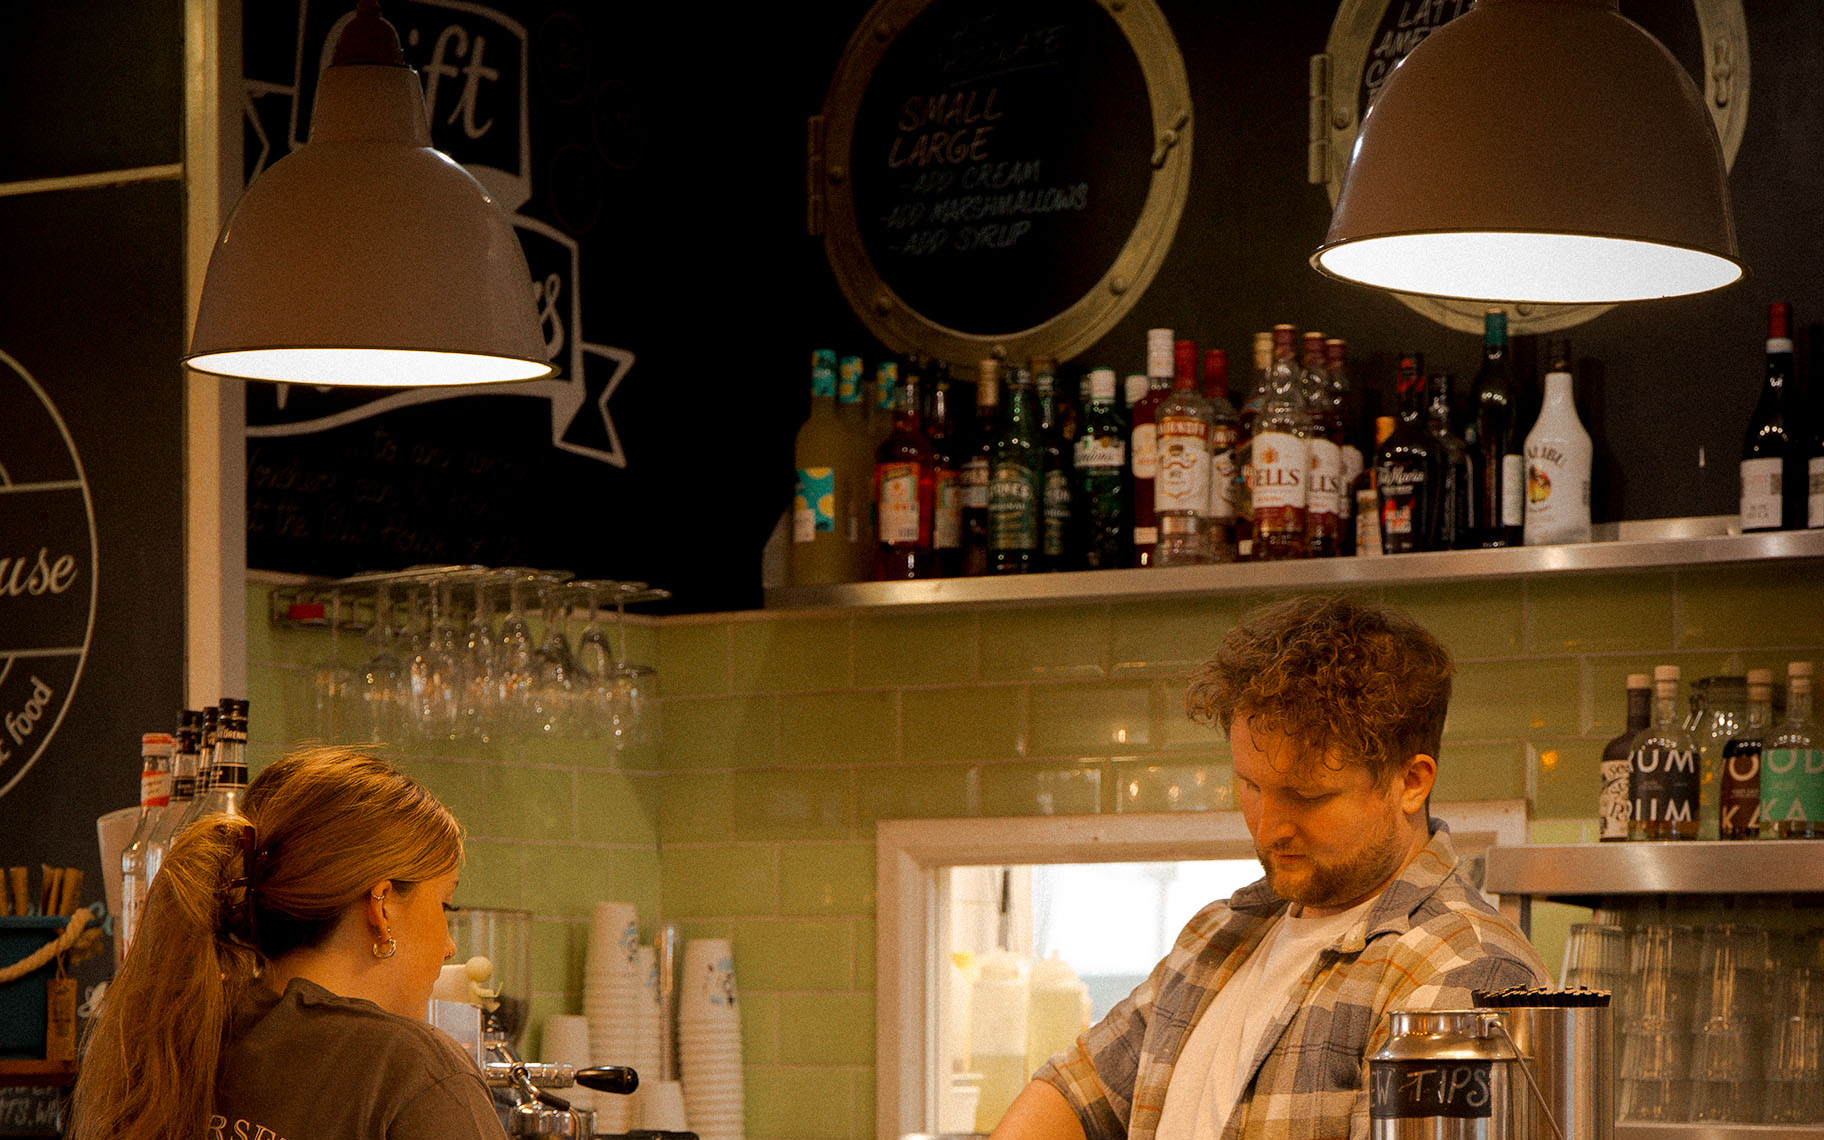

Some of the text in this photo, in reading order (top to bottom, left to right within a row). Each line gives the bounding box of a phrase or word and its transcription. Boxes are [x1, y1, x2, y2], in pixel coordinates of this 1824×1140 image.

[898, 87, 1004, 132] SMALL
[887, 126, 996, 168] LARGE
[961, 159, 1042, 189] CREAM
[929, 183, 1089, 224] MARSHMALLOWS
[953, 220, 1033, 252] SYRUP
[1254, 468, 1301, 487] ELLS
[0, 547, 79, 597] use
[5, 675, 54, 747] food
[1404, 1065, 1490, 1108] TIPS
